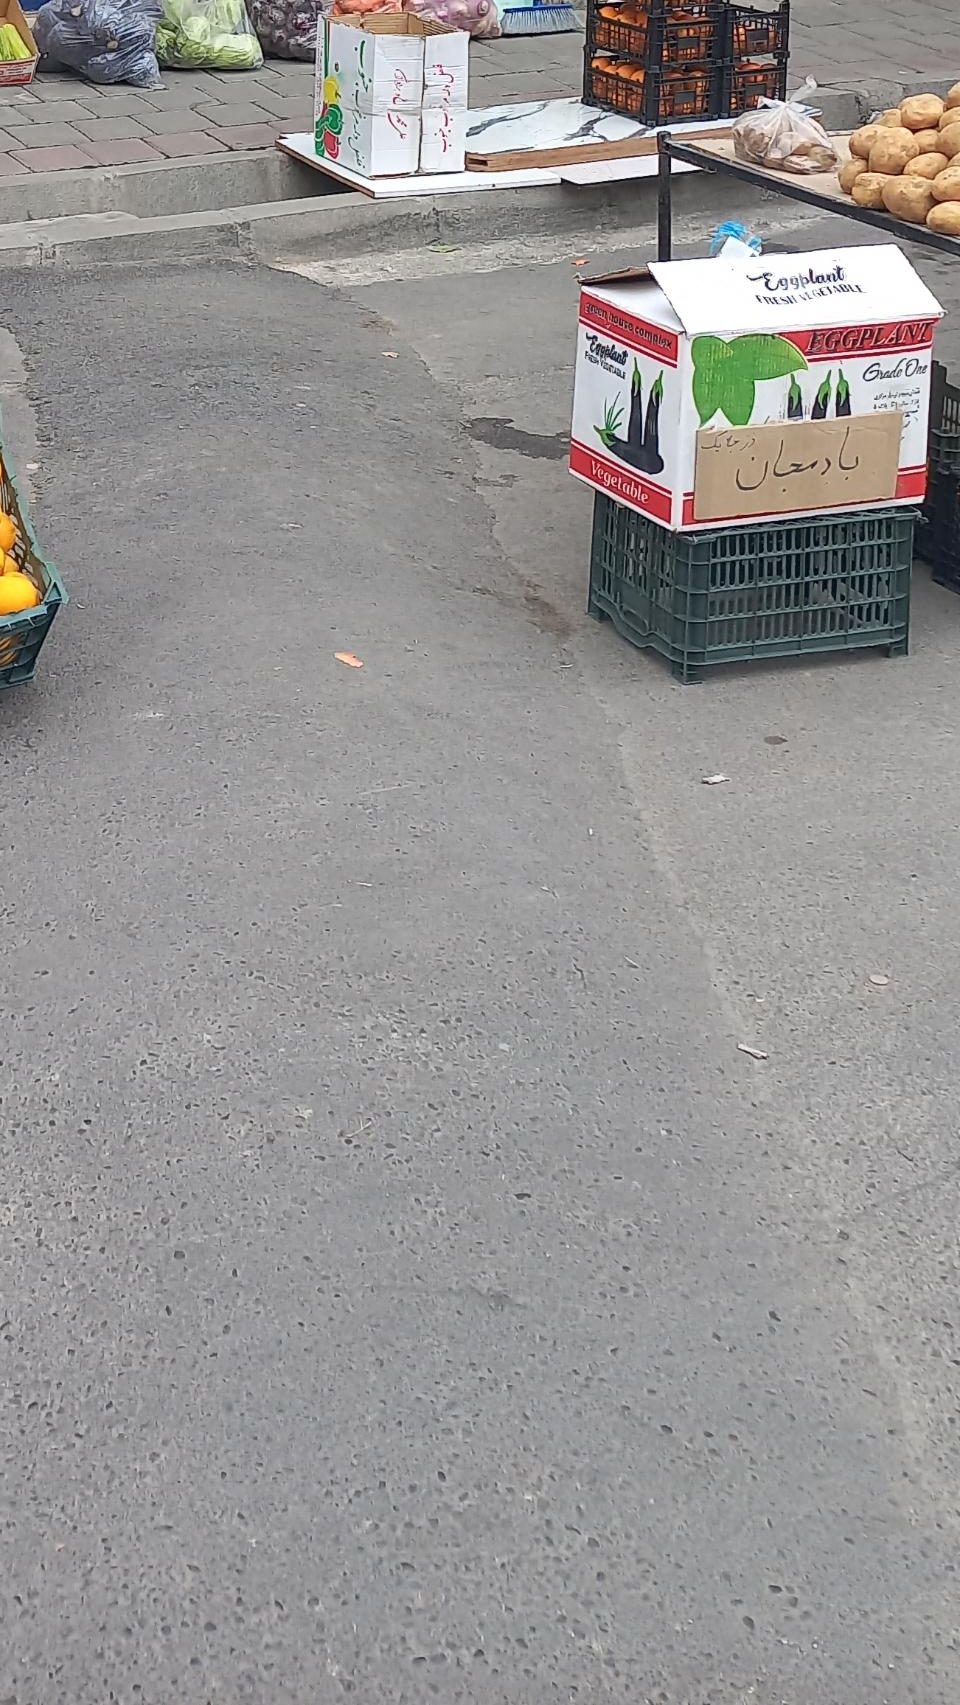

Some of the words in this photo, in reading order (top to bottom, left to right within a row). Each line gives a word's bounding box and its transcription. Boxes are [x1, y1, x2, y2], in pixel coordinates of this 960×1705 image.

[746, 265, 845, 292] Eggplant
[755, 294, 798, 305] FRESH
[799, 283, 867, 301] VEGETABLE
[586, 332, 629, 366] Eggplant
[634, 325, 672, 351] complex
[807, 321, 935, 354] EGGPLANT
[863, 358, 906, 382] Grade
[905, 358, 928, 377] One
[735, 425, 859, 493] بادمجان
[591, 459, 649, 504] Vegetable
